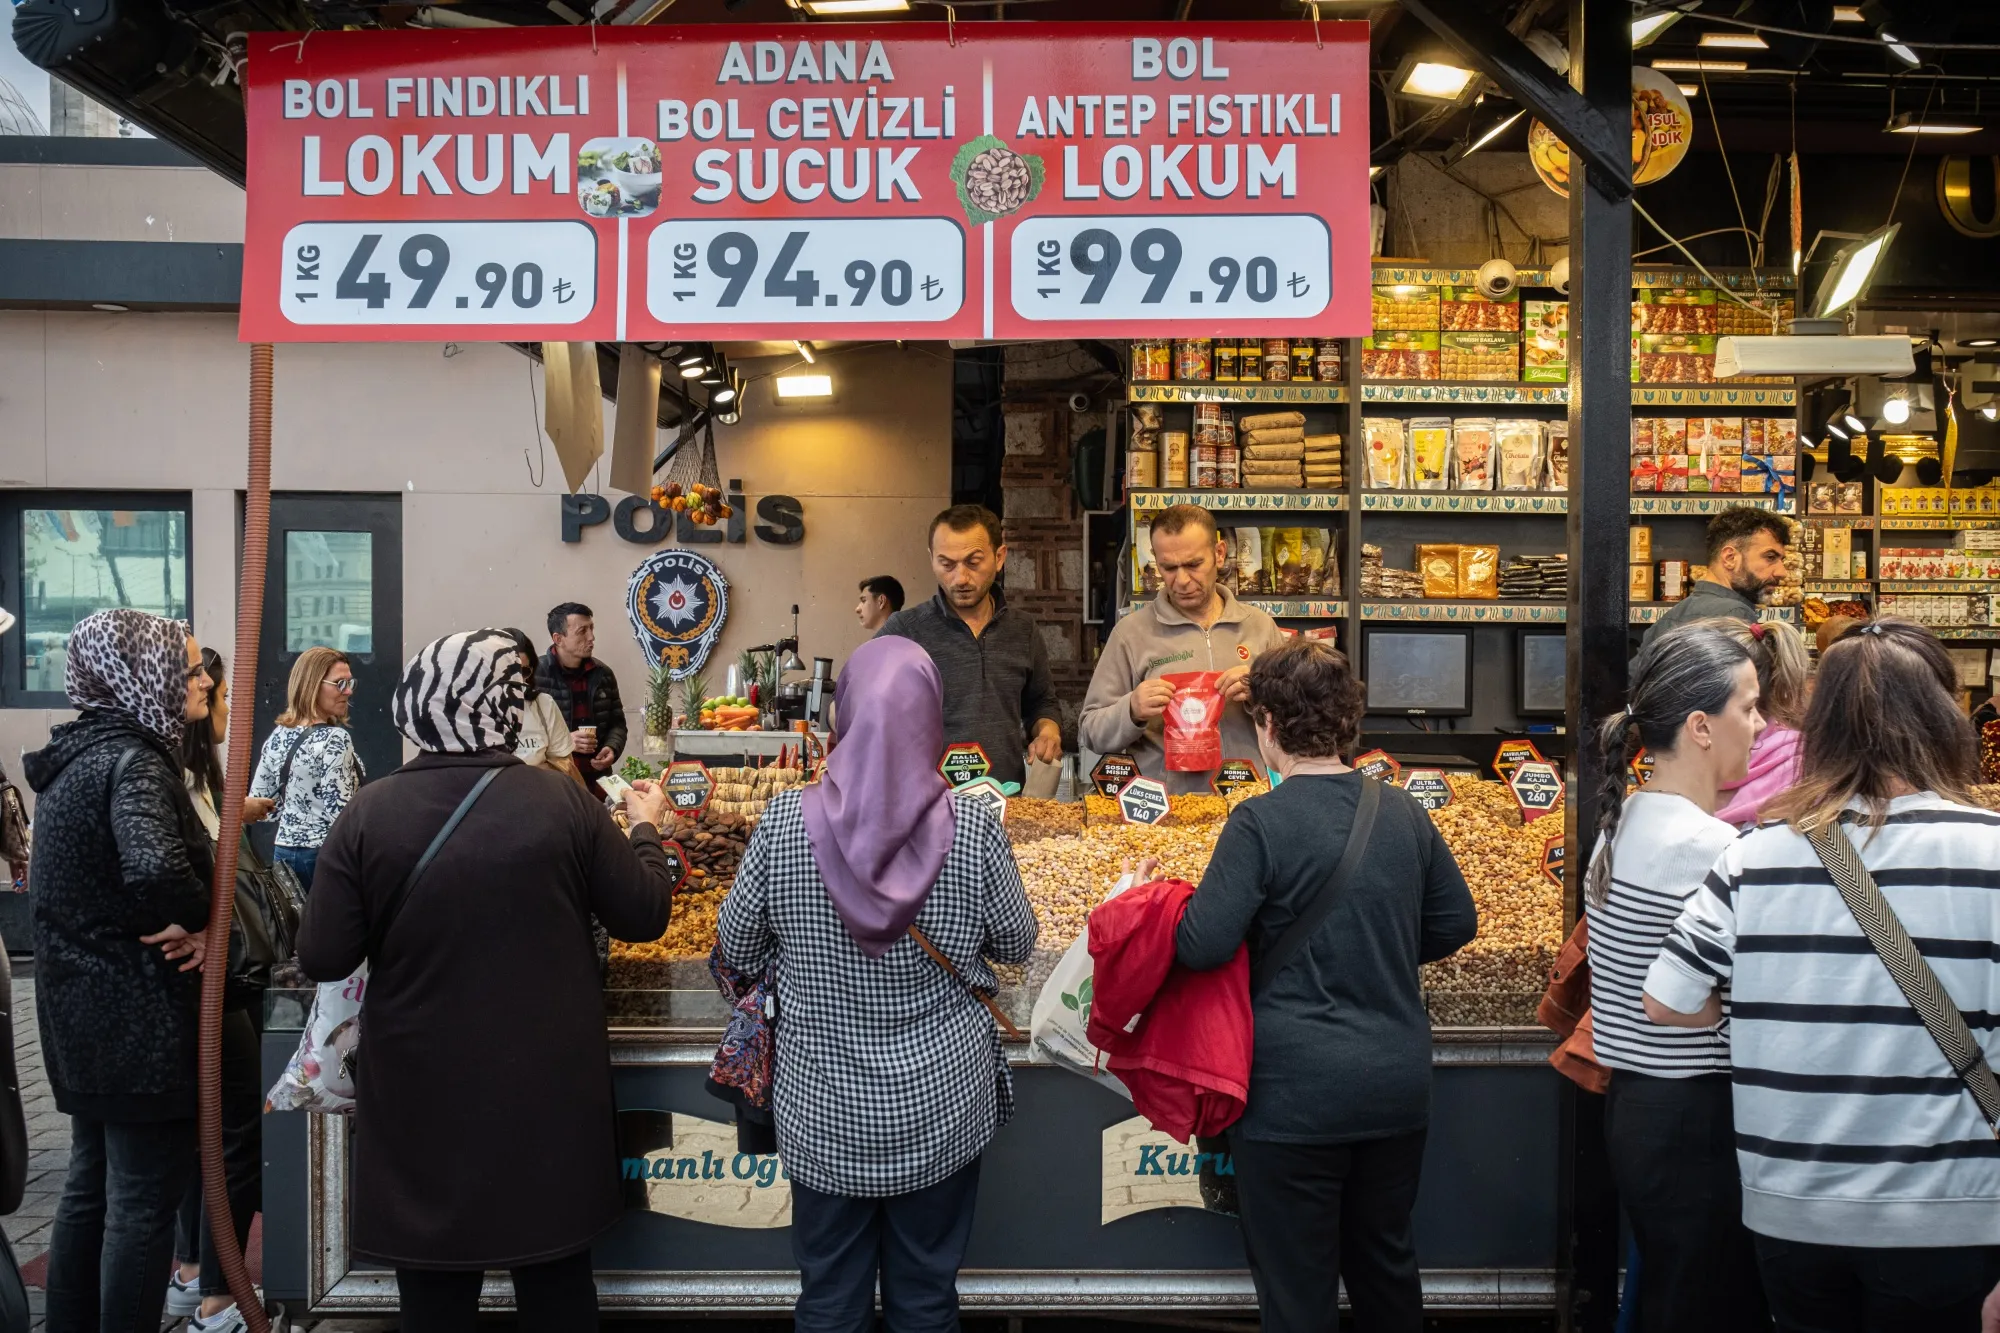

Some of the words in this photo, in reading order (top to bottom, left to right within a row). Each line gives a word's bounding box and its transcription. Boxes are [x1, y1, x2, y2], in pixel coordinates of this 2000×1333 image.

[717, 40, 895, 85] ADANA
[1131, 37, 1230, 82] BOL
[283, 78, 374, 119] BOL
[387, 75, 590, 118] FINDIKLI
[657, 98, 755, 142] BOL
[767, 86, 956, 141] CEVİZLİ
[1016, 94, 1156, 139] ANTEP
[1168, 93, 1342, 138] FISTIKLI
[302, 133, 571, 197] LOKUM
[692, 147, 922, 203] SUCUK
[1063, 143, 1297, 200] LOKUM
[295, 244, 321, 282] KG
[673, 242, 697, 280] KG
[1037, 238, 1061, 277] KG
[561, 479, 805, 544] POLİS
[652, 557, 705, 575] POLİS
[954, 771, 971, 782] 120
[1106, 783, 1118, 794] 80
[676, 793, 696, 806] 180
[1132, 807, 1150, 820] 140
[1144, 791, 1163, 802] ÇEREZ
[1527, 791, 1546, 803] 260
